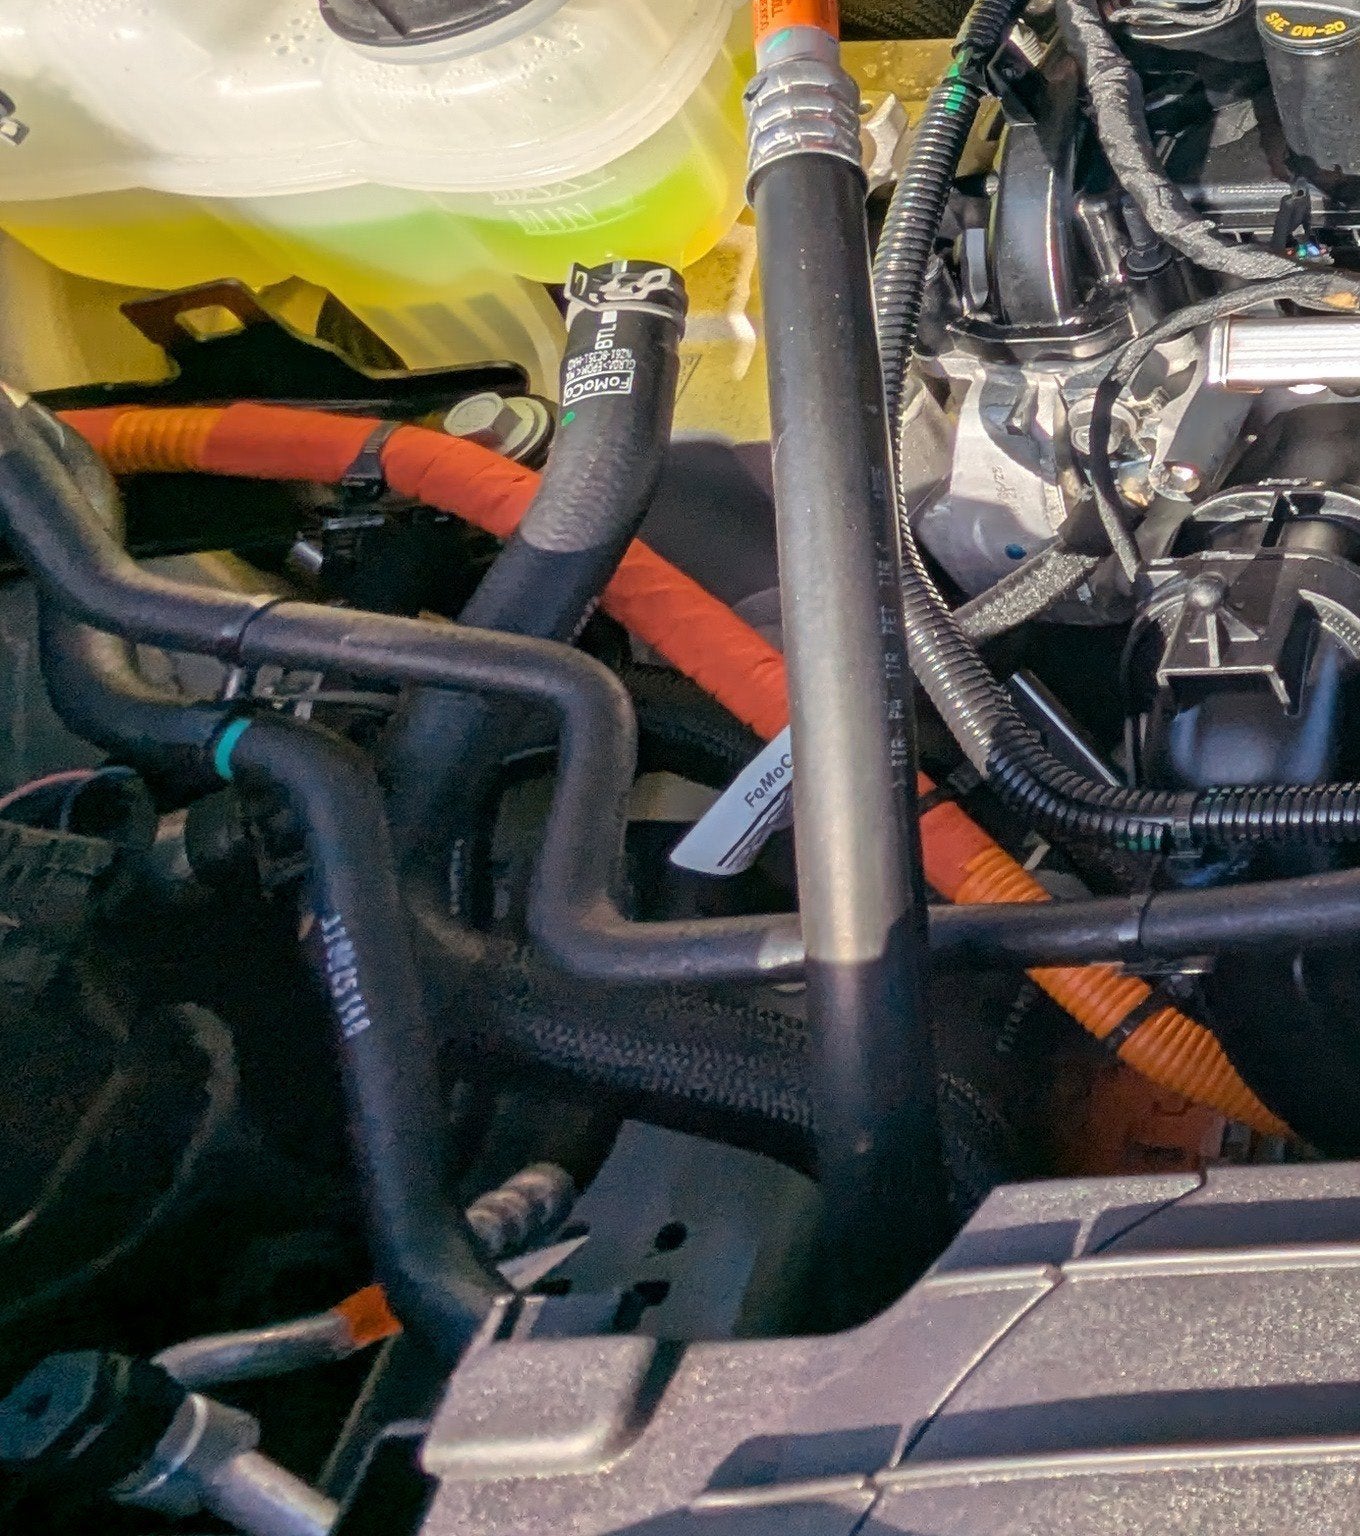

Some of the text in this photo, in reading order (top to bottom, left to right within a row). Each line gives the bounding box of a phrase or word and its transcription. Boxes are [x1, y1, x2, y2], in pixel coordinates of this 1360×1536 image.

[1265, 12, 1347, 37] SAE 0W-20
[565, 375, 631, 399] FoMoCo
[744, 753, 792, 808] FoMoC
